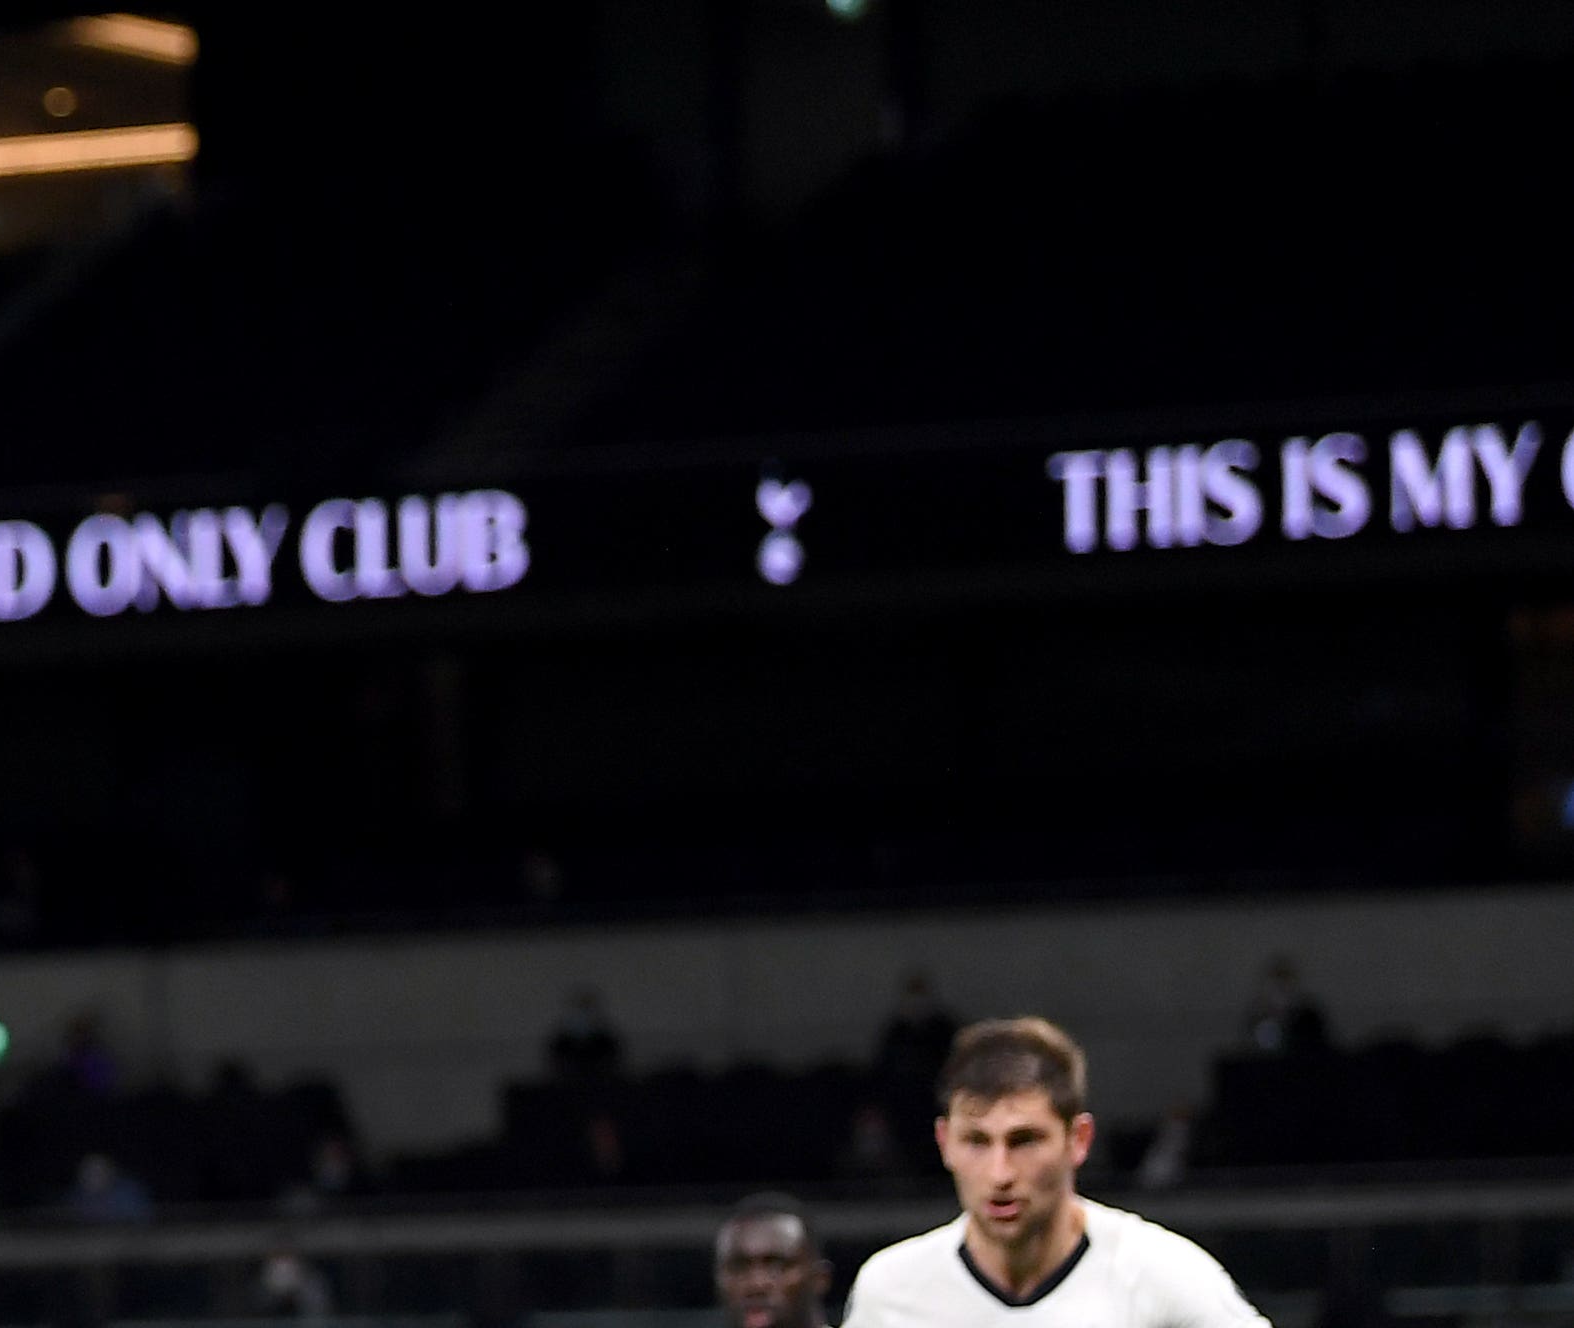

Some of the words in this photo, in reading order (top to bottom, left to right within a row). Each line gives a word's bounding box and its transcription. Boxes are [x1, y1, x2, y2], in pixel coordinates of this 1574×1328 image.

[66, 502, 291, 617] ONLY
[298, 488, 533, 602] CLUB
[1047, 438, 1263, 554] THIS
[1280, 433, 1372, 541] IS
[1389, 420, 1542, 534] MY
